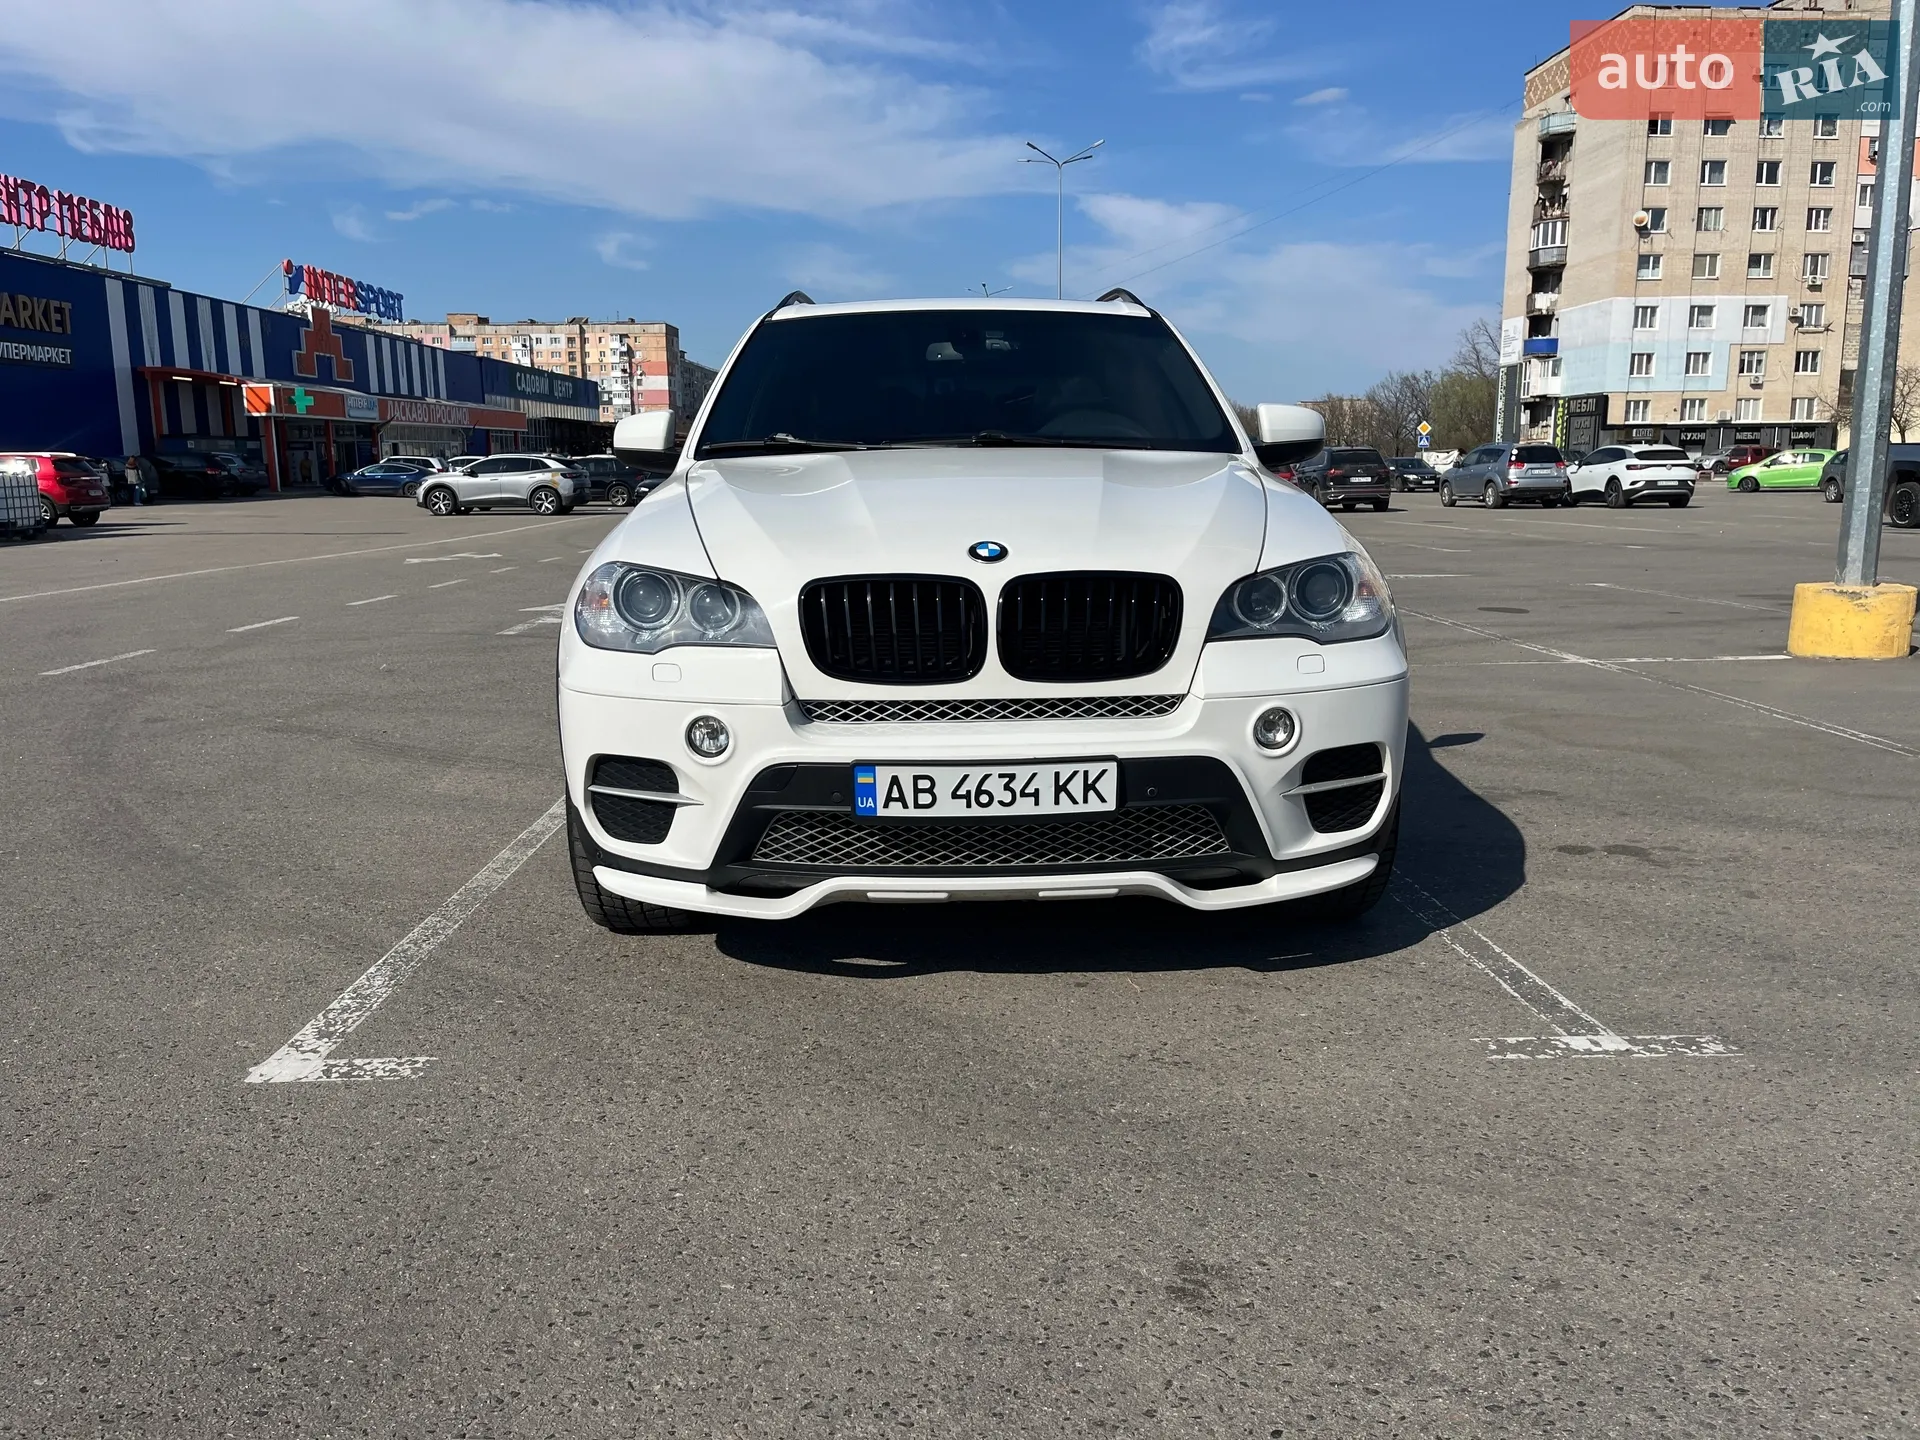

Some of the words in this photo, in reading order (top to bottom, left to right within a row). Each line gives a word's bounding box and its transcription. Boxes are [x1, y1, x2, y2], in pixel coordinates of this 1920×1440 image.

[0, 173, 51, 232] НТР
[53, 190, 135, 253] МЕБЛІВ
[304, 264, 404, 323] INTERSPORT
[516, 371, 550, 395] САДОВИЙ
[553, 380, 573, 399] ЦЕНТР
[387, 401, 429, 422] ЛАСКАВО
[430, 404, 470, 425] ПРОСИМО!
[1570, 398, 1596, 413] МЕБЛІ
[1680, 432, 1706, 440] КУХНІ
[1736, 432, 1761, 440] МЕБЛІ
[1791, 431, 1815, 440] ШАФИ
[882, 774, 938, 809] AB
[951, 772, 1040, 809] 4634
[1053, 769, 1109, 805] KK
[858, 796, 875, 808] UA
